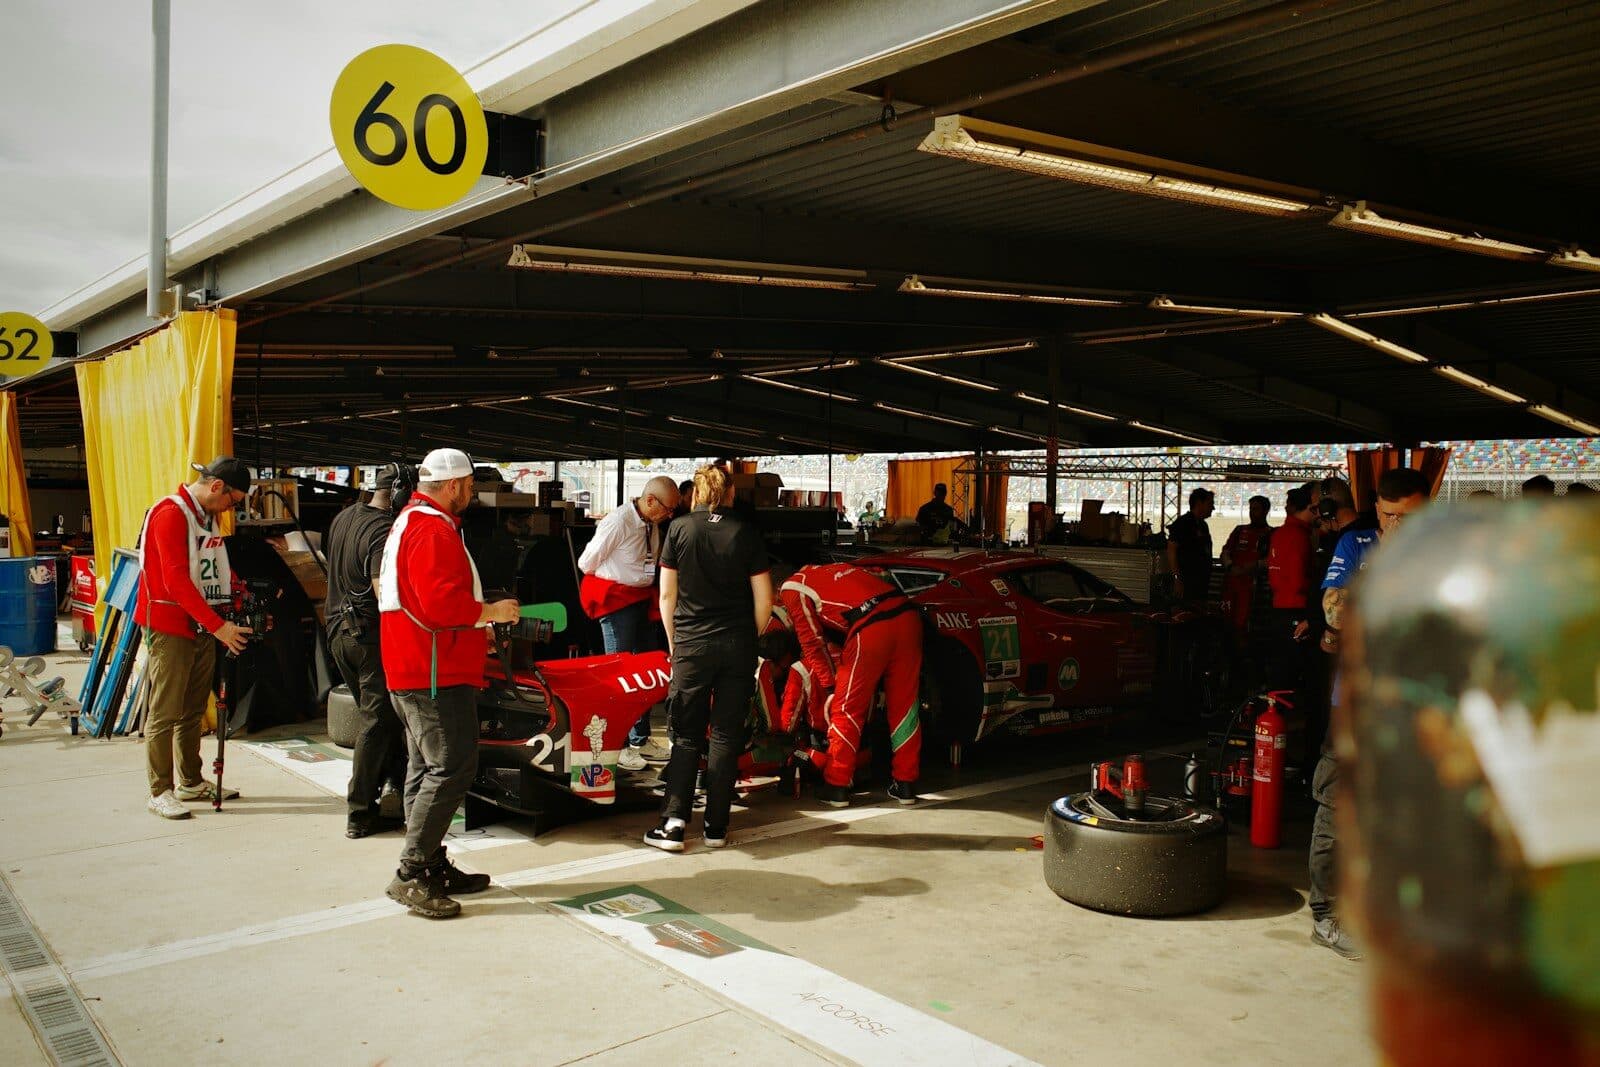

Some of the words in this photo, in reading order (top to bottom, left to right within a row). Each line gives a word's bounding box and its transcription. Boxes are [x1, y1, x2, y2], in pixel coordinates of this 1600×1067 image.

[353, 81, 467, 175] 60
[0, 326, 40, 360] 62
[936, 612, 972, 629] AIKE
[987, 630, 1012, 658] 21
[526, 732, 572, 773] 21
